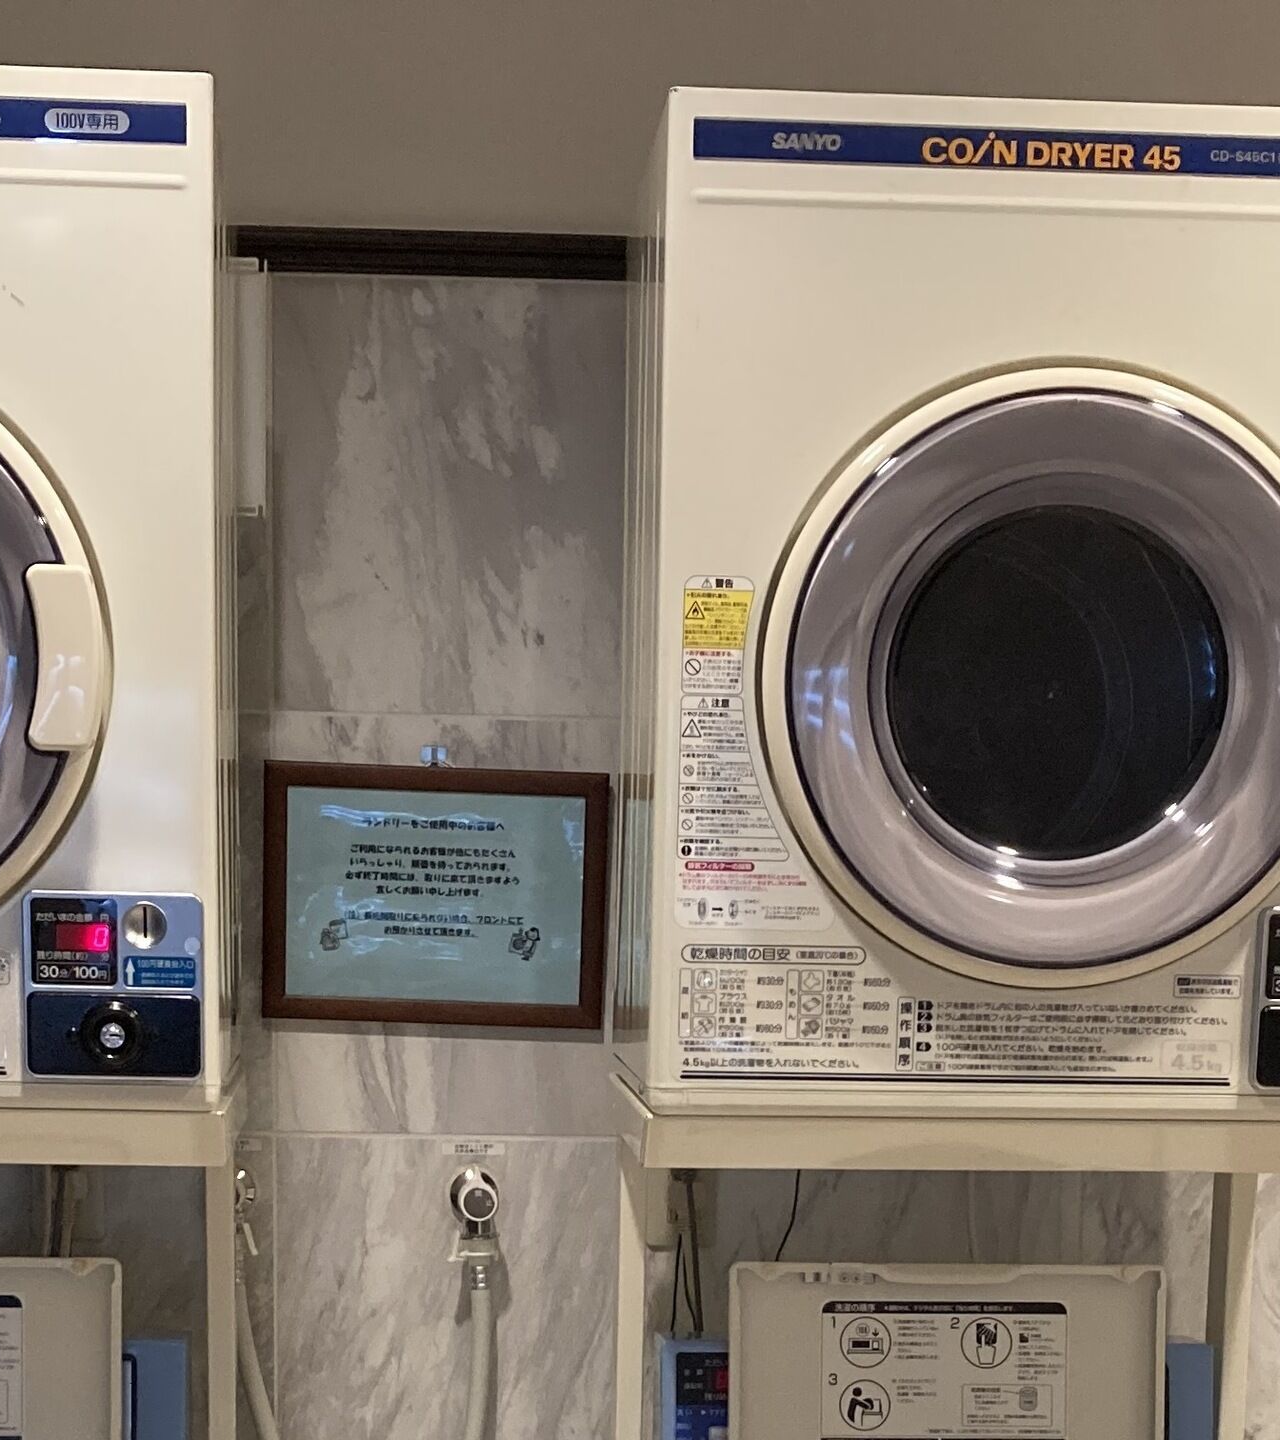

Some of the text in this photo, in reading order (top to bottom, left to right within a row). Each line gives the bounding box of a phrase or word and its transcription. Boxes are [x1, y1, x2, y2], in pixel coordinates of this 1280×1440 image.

[53, 111, 119, 131] 100V専用
[773, 132, 840, 151] SANYO
[1026, 140, 1134, 168] DRYER
[1144, 146, 1180, 169] 45
[716, 579, 733, 588] 警告
[712, 699, 729, 707] 注意
[94, 928, 108, 947] 0
[691, 948, 790, 960] 乾燥時間の目安
[898, 1002, 912, 1066] 操作順序
[683, 1058, 859, 1068] 4.5kg以上の洗濯物を入れないでください。
[832, 1316, 835, 1328] 1
[951, 1318, 960, 1329] 2
[828, 1374, 837, 1385] 3
